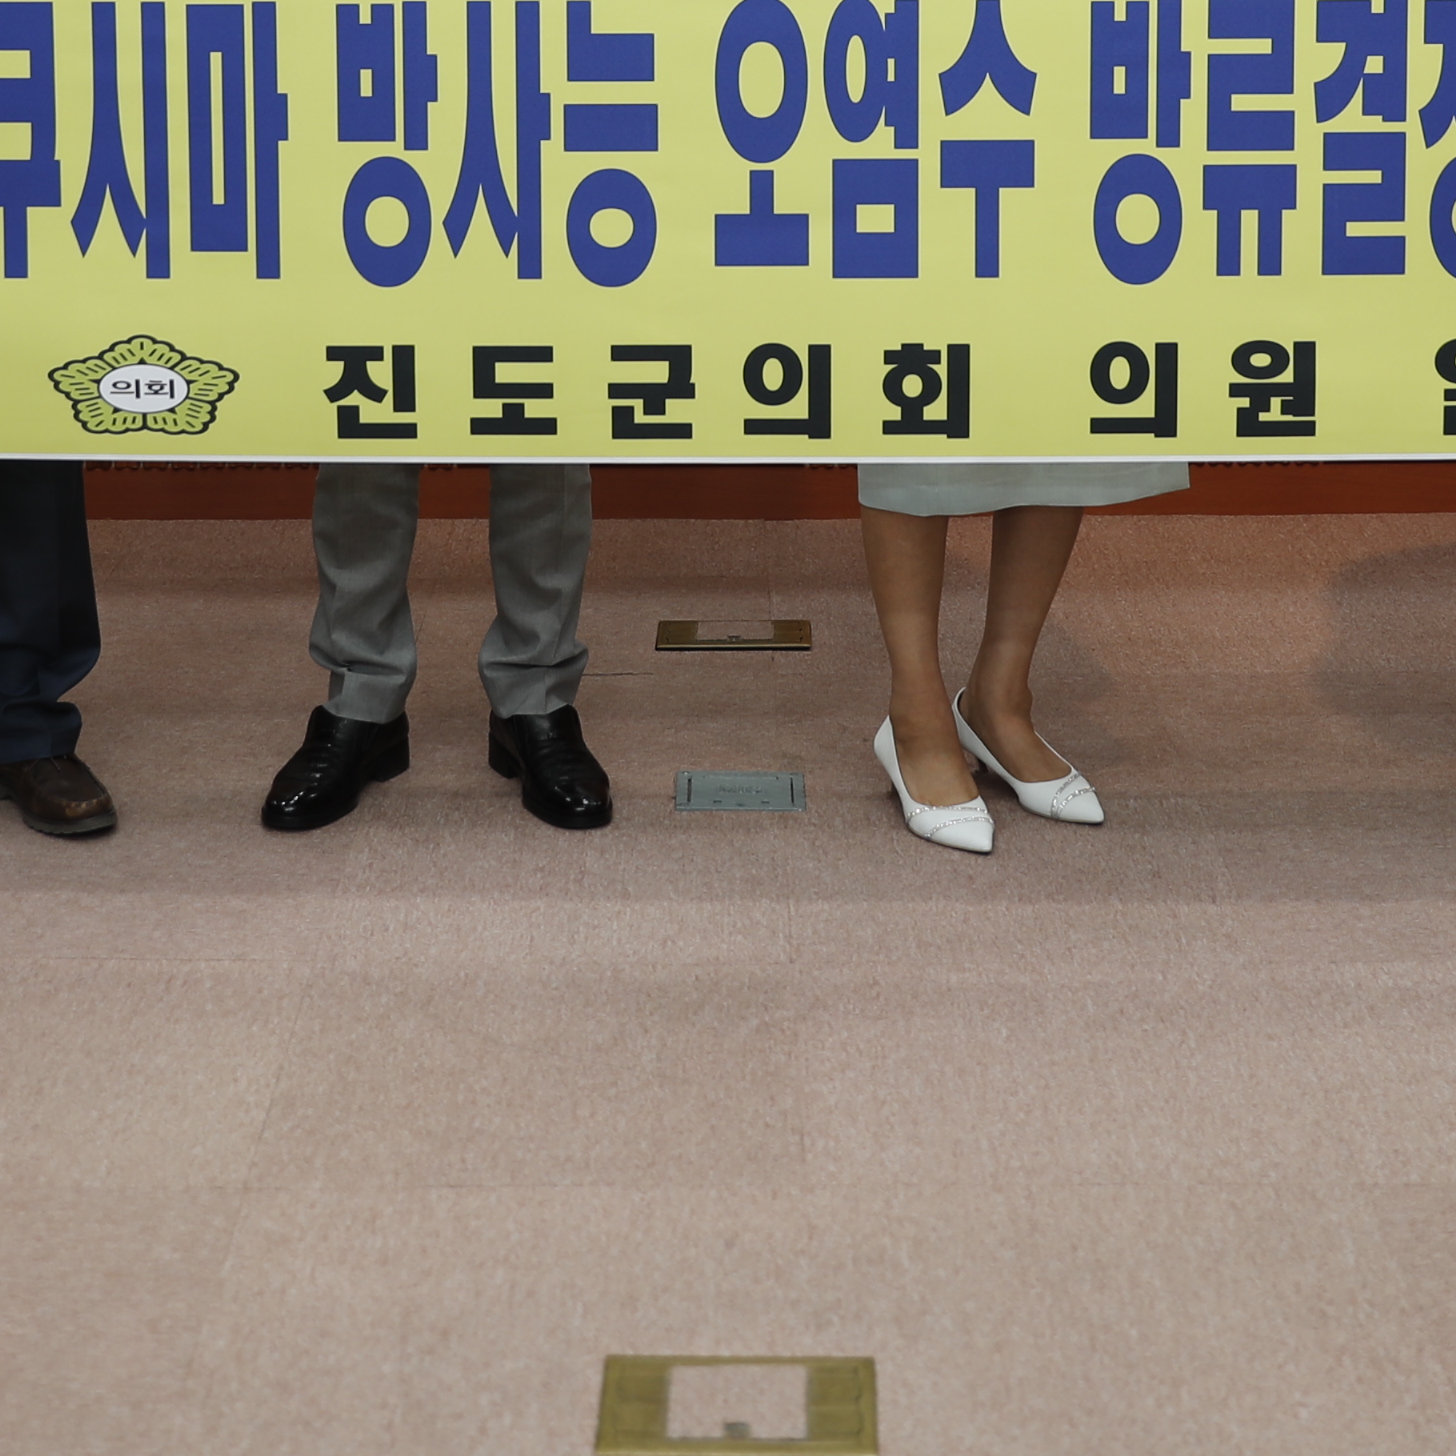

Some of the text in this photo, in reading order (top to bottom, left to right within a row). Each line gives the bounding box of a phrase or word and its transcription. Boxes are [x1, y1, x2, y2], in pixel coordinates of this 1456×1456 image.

[335, 0, 659, 288] 방사능
[99, 378, 176, 400] 의회
[324, 343, 971, 440] 진도군의회
[1090, 339, 1317, 438] 의원
